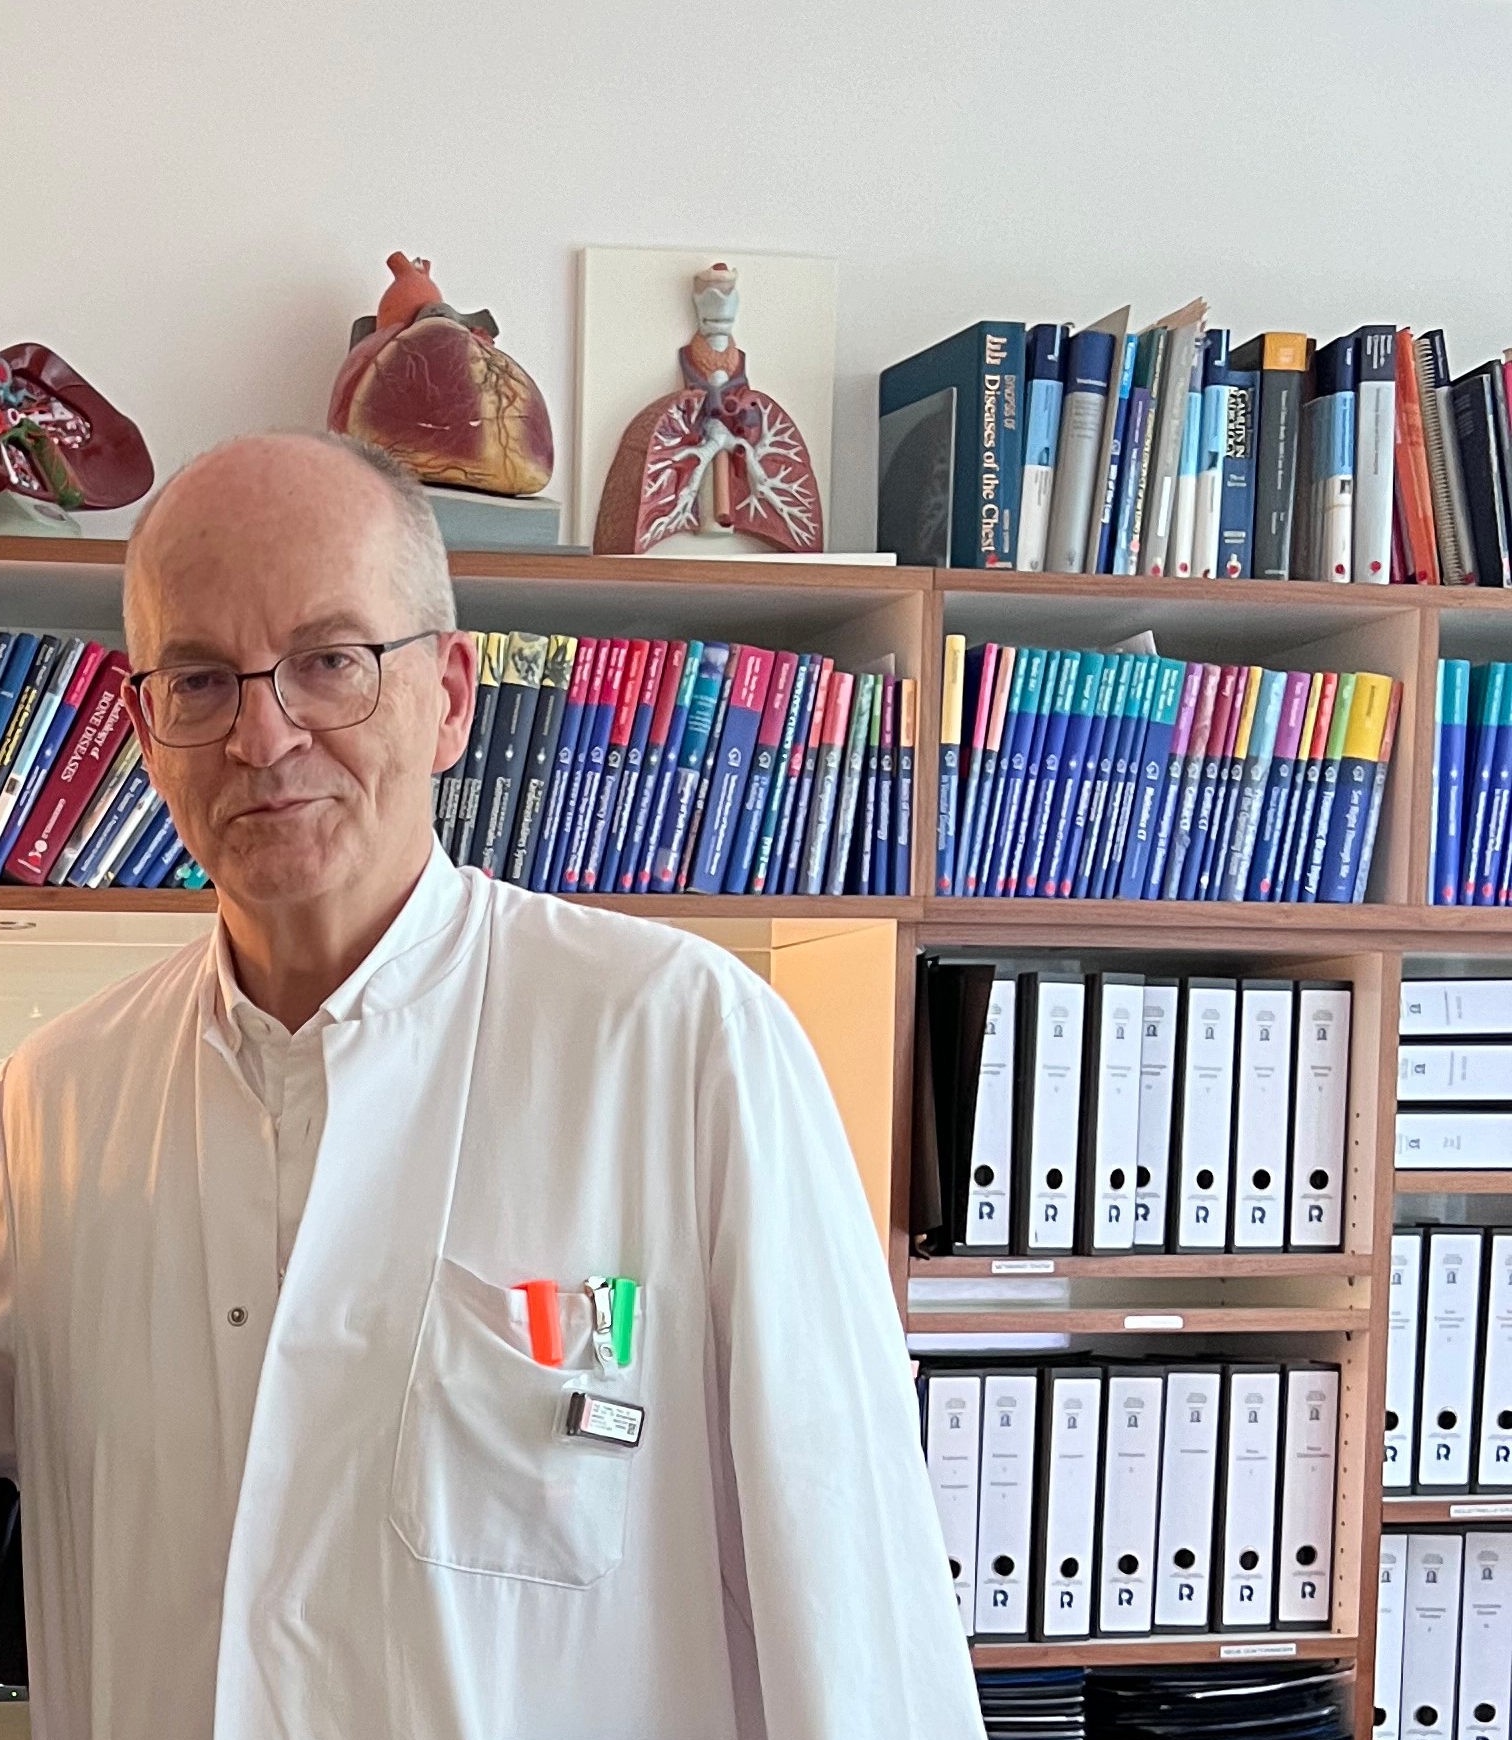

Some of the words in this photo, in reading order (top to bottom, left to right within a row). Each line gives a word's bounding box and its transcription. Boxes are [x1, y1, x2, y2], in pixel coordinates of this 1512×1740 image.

[982, 373, 1000, 447] Diseases
[982, 451, 998, 469] of
[981, 473, 998, 499] the
[980, 503, 998, 552] Chest
[87, 691, 115, 728] BONE
[60, 726, 96, 784] DISEASES
[89, 744, 102, 762] of
